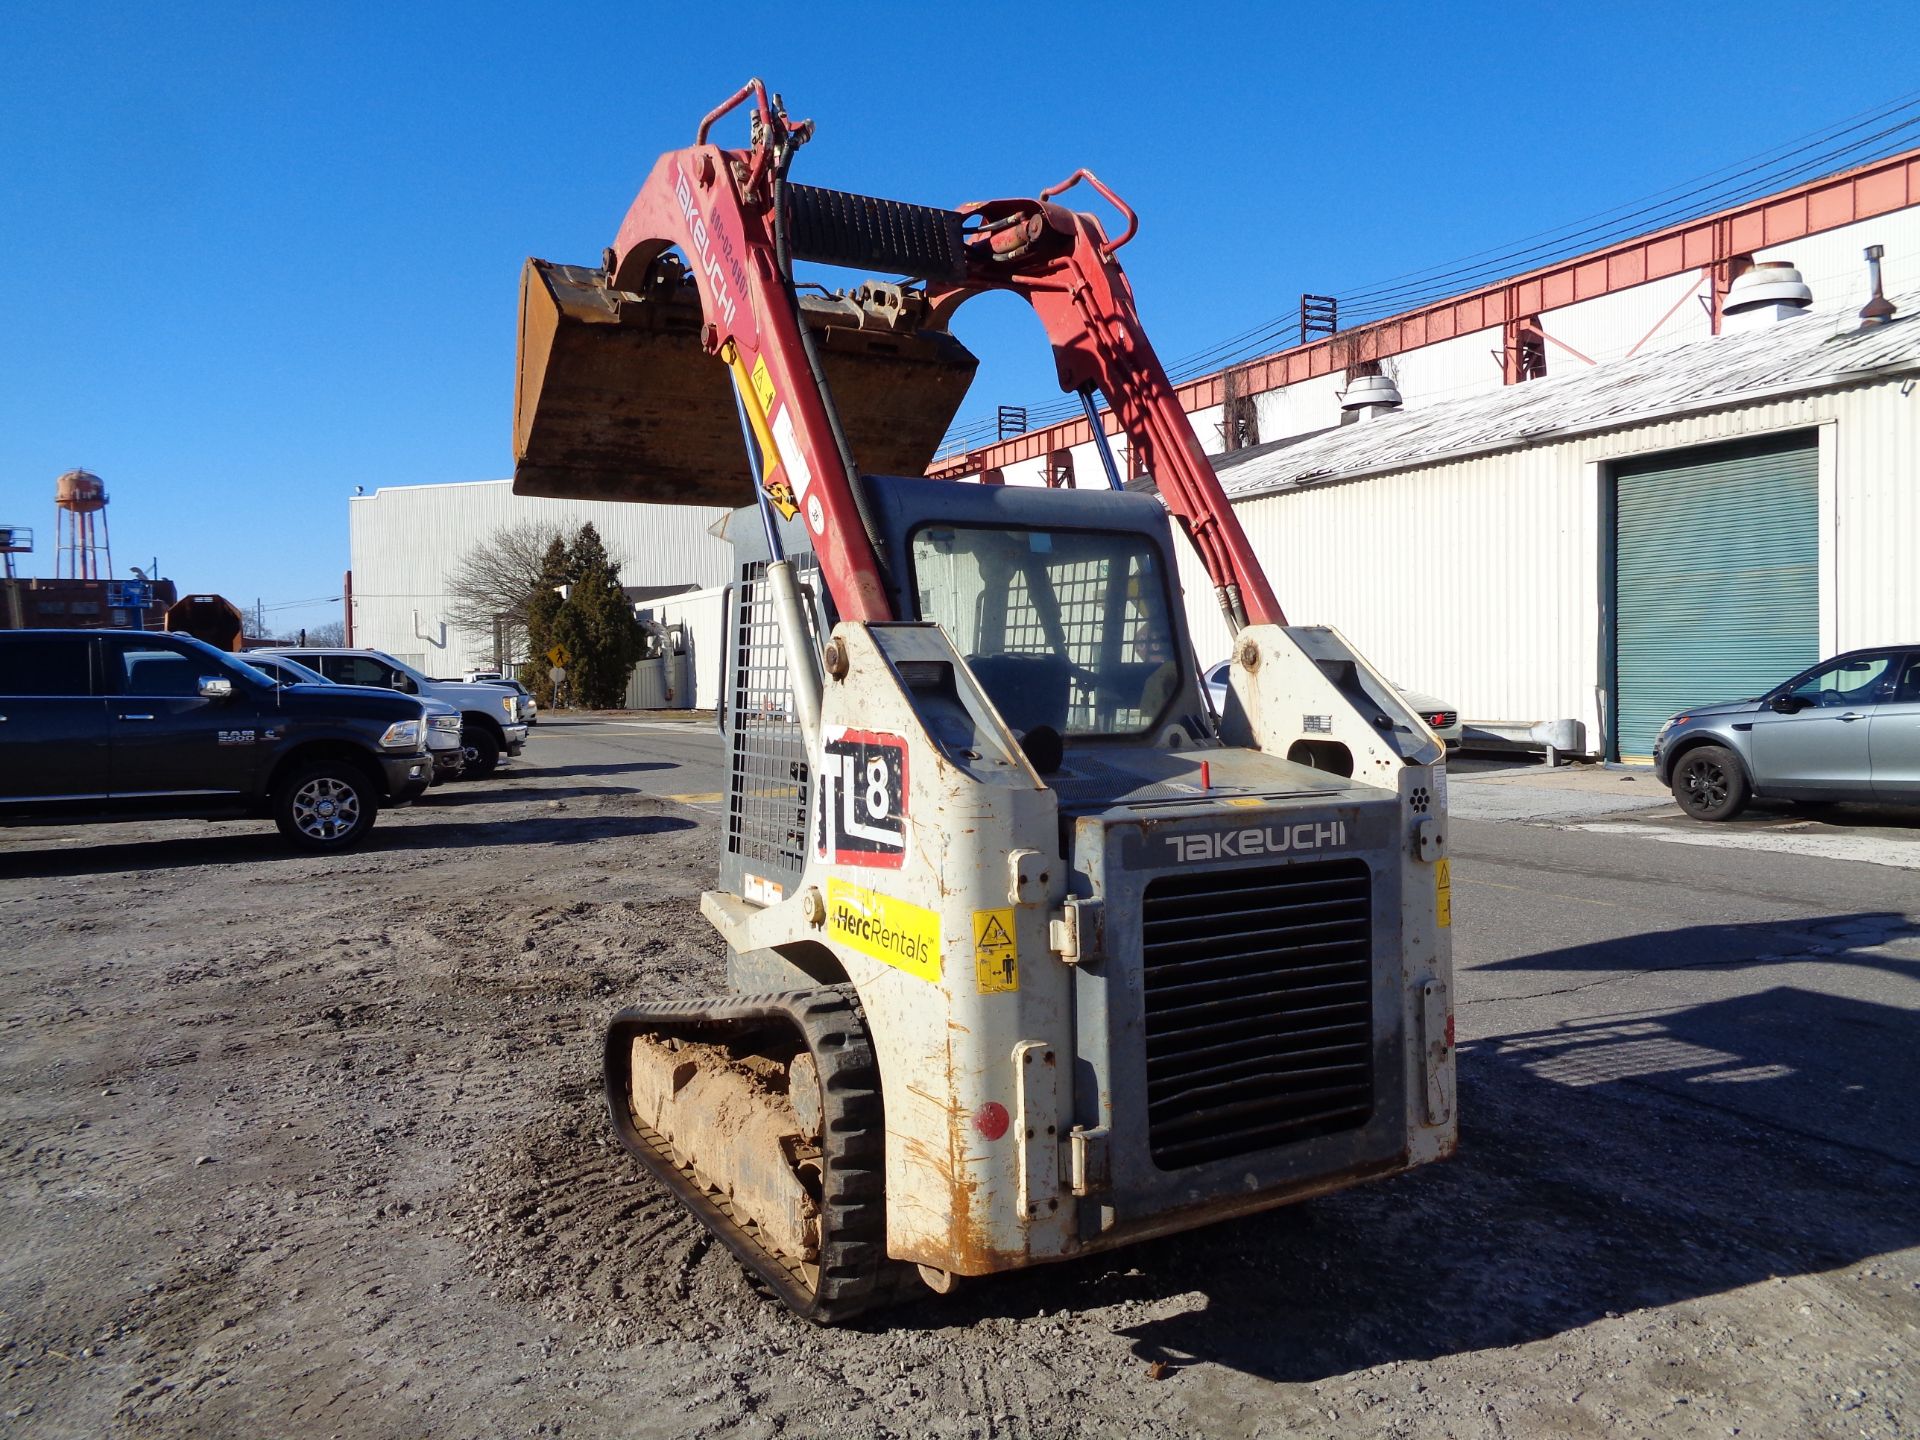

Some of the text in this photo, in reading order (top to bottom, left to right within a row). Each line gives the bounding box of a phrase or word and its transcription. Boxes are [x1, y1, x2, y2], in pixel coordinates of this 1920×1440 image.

[676, 160, 736, 329] TAKEUCHI
[820, 752, 904, 865] TL8
[1165, 820, 1346, 862] TAKEUCHI
